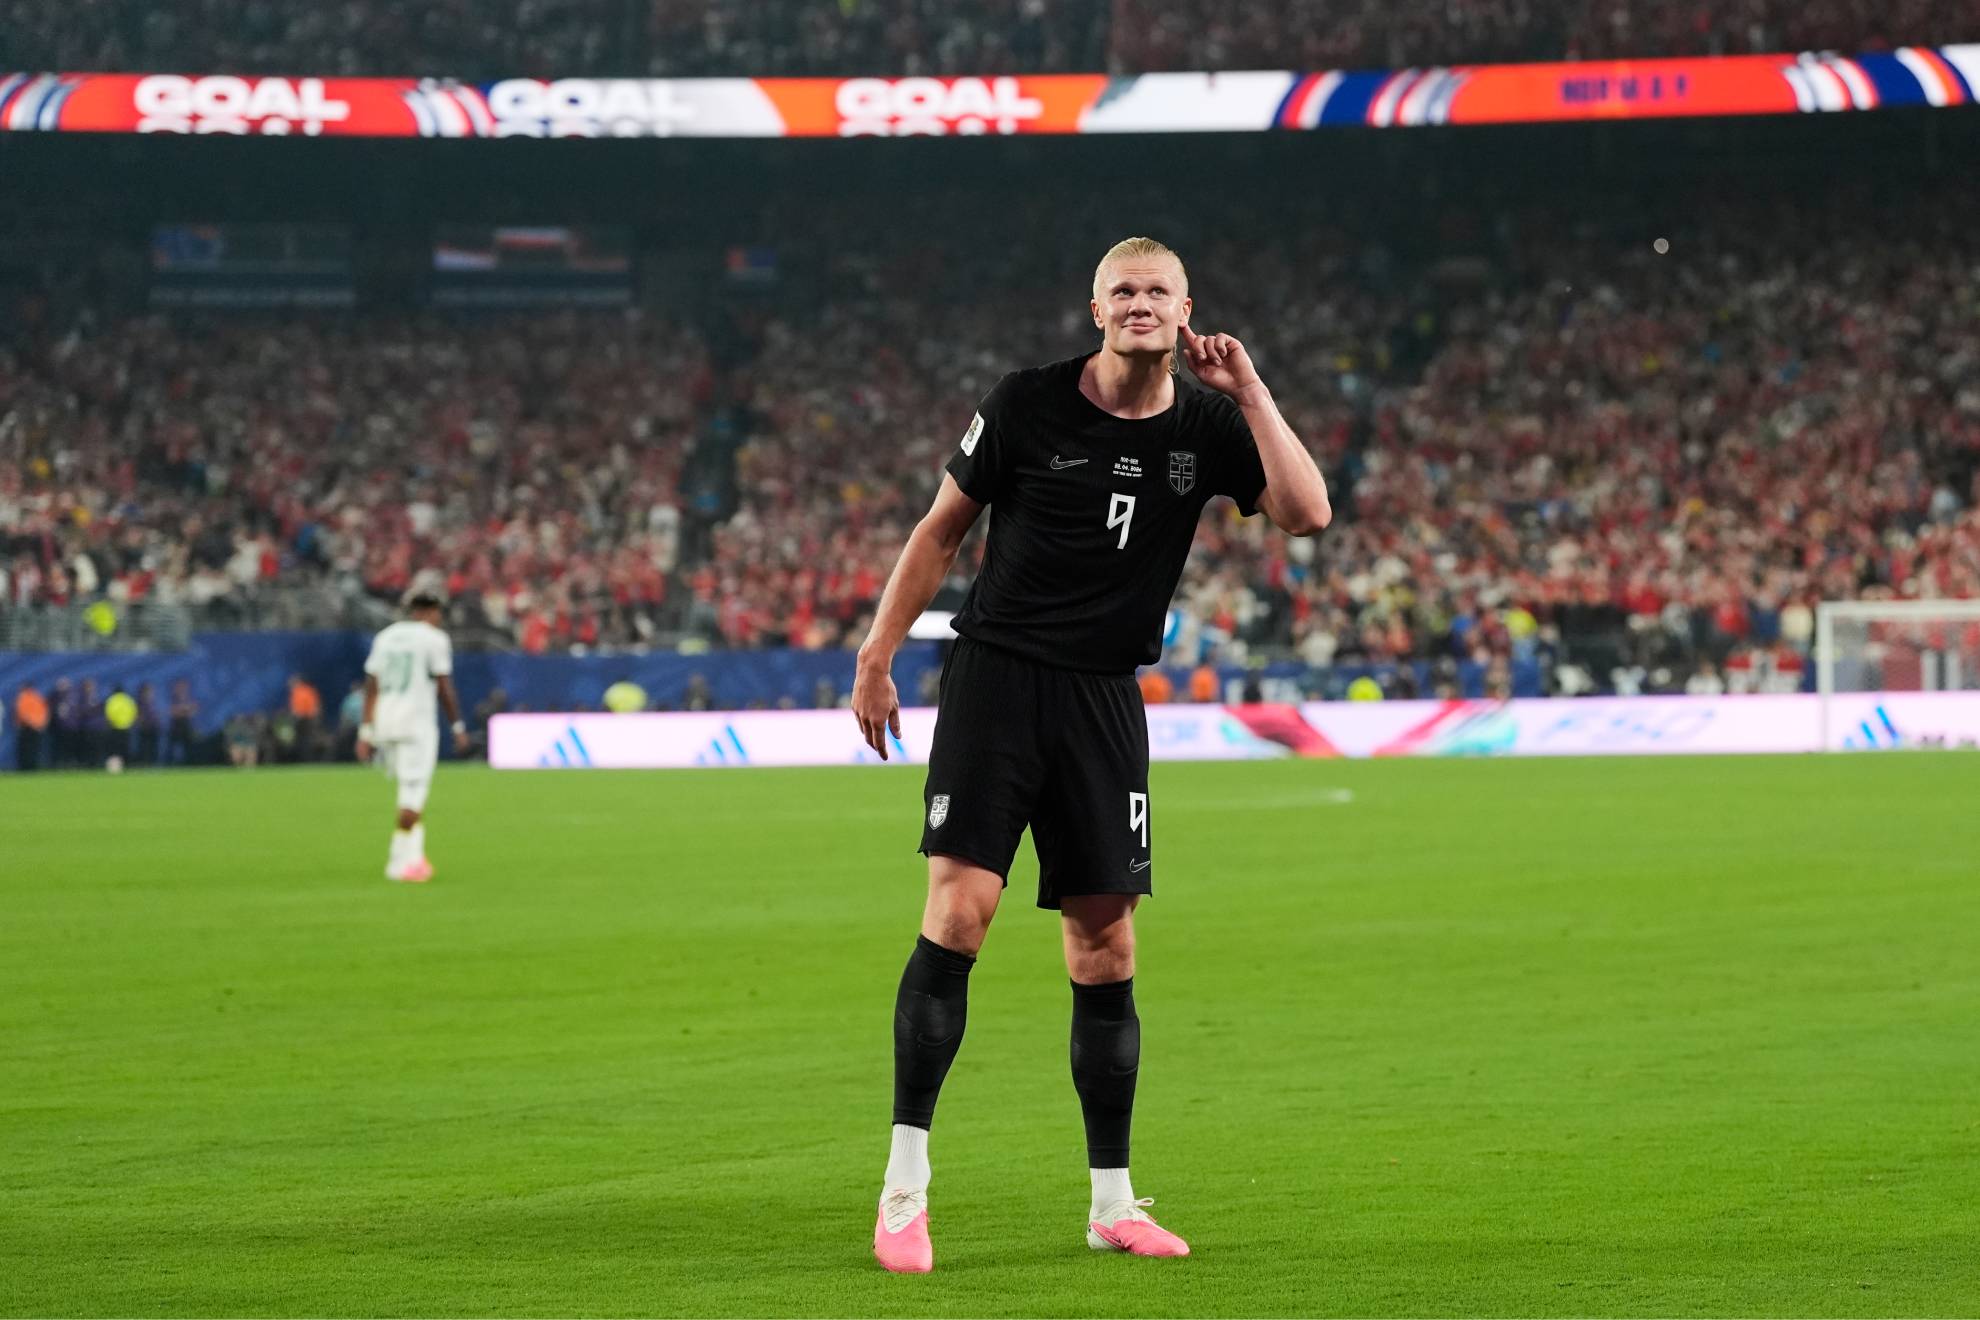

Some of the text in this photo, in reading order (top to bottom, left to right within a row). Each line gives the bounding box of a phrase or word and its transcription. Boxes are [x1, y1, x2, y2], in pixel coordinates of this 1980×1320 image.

[134, 74, 349, 121] GOAL
[489, 78, 693, 121] GOAL
[835, 76, 1043, 119] GOAL
[1106, 493, 1136, 549] 9
[1129, 791, 1147, 848] 9
